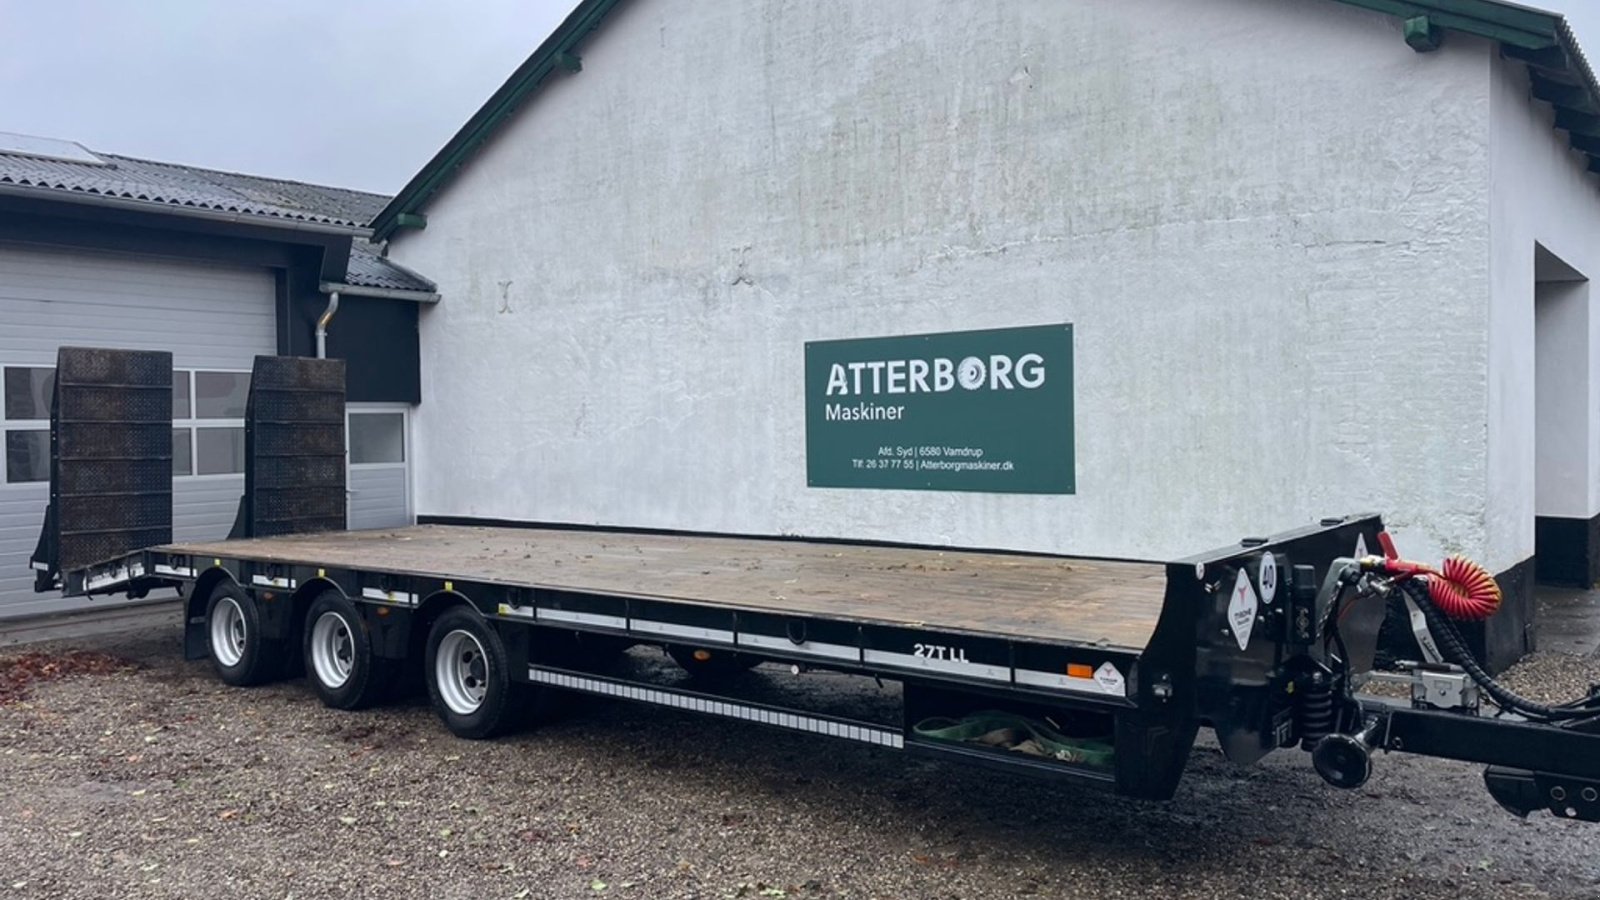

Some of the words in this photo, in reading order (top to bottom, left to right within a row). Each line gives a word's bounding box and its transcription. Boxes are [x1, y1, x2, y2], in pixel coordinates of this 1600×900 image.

[826, 353, 1045, 395] ATTERBORG
[825, 402, 904, 420] Maskiner
[896, 446, 913, 458] Syd
[919, 446, 941, 456] 6580
[942, 447, 983, 458] Vamdrup
[866, 459, 877, 469] 26
[879, 459, 889, 469] 37
[891, 460, 901, 469] 77
[903, 460, 914, 469] 55
[920, 460, 1014, 472] Atterborgmaskiner.dk
[1262, 564, 1275, 590] 40
[913, 643, 946, 660] 27T
[950, 647, 969, 664] LL
